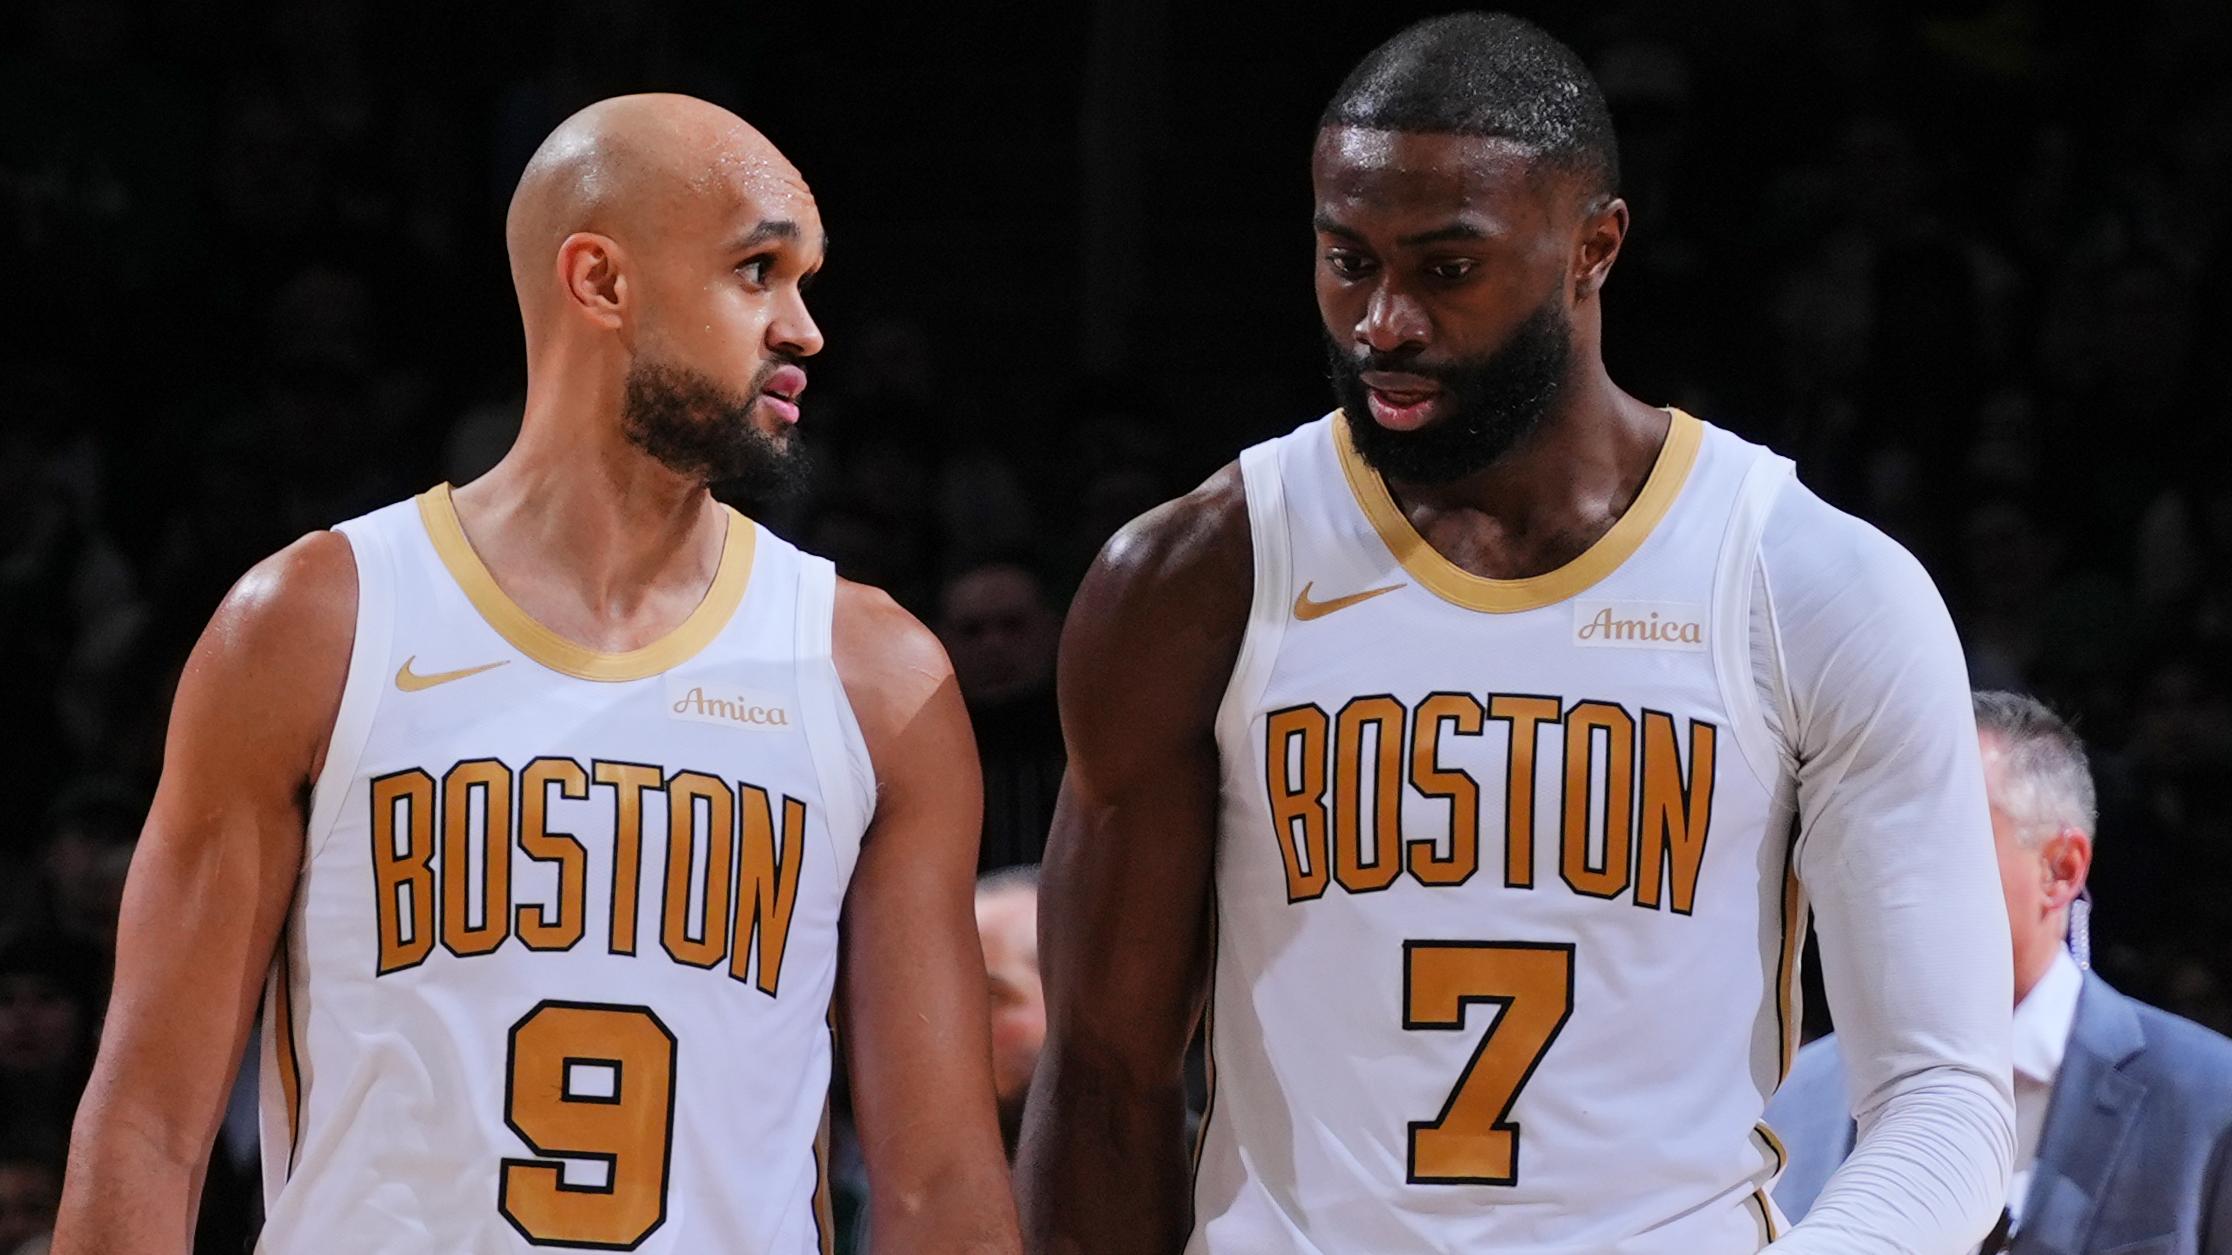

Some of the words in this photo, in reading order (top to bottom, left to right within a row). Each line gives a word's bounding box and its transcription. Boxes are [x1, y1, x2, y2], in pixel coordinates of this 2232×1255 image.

[673, 687, 789, 725] Amica
[1579, 608, 1703, 643] Amica
[370, 756, 806, 999] BOSTON
[1266, 691, 1717, 917] BOSTON
[498, 999, 678, 1252] 9
[1402, 940, 1576, 1186] 7
